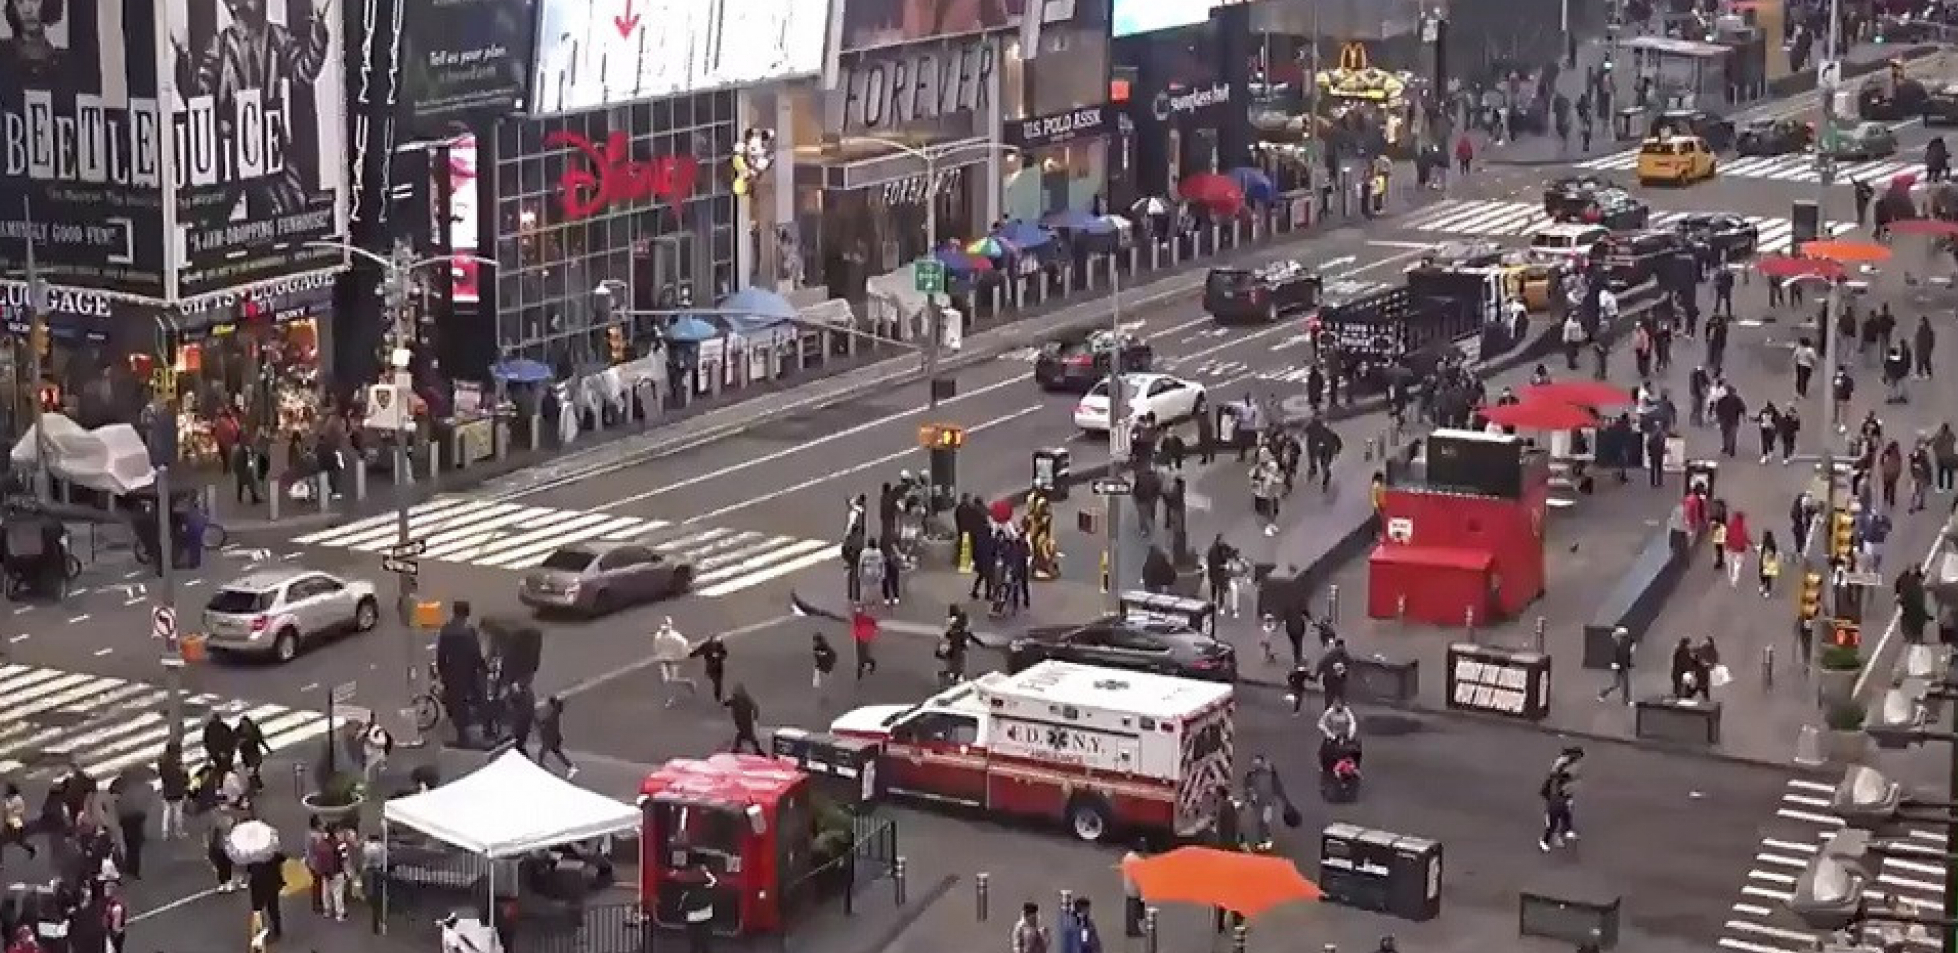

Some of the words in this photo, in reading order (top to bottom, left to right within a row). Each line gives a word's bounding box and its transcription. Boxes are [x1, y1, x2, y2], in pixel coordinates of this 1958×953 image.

[842, 40, 994, 131] FOREVER
[1043, 112, 1071, 136] POLO
[544, 129, 697, 219] Disney
